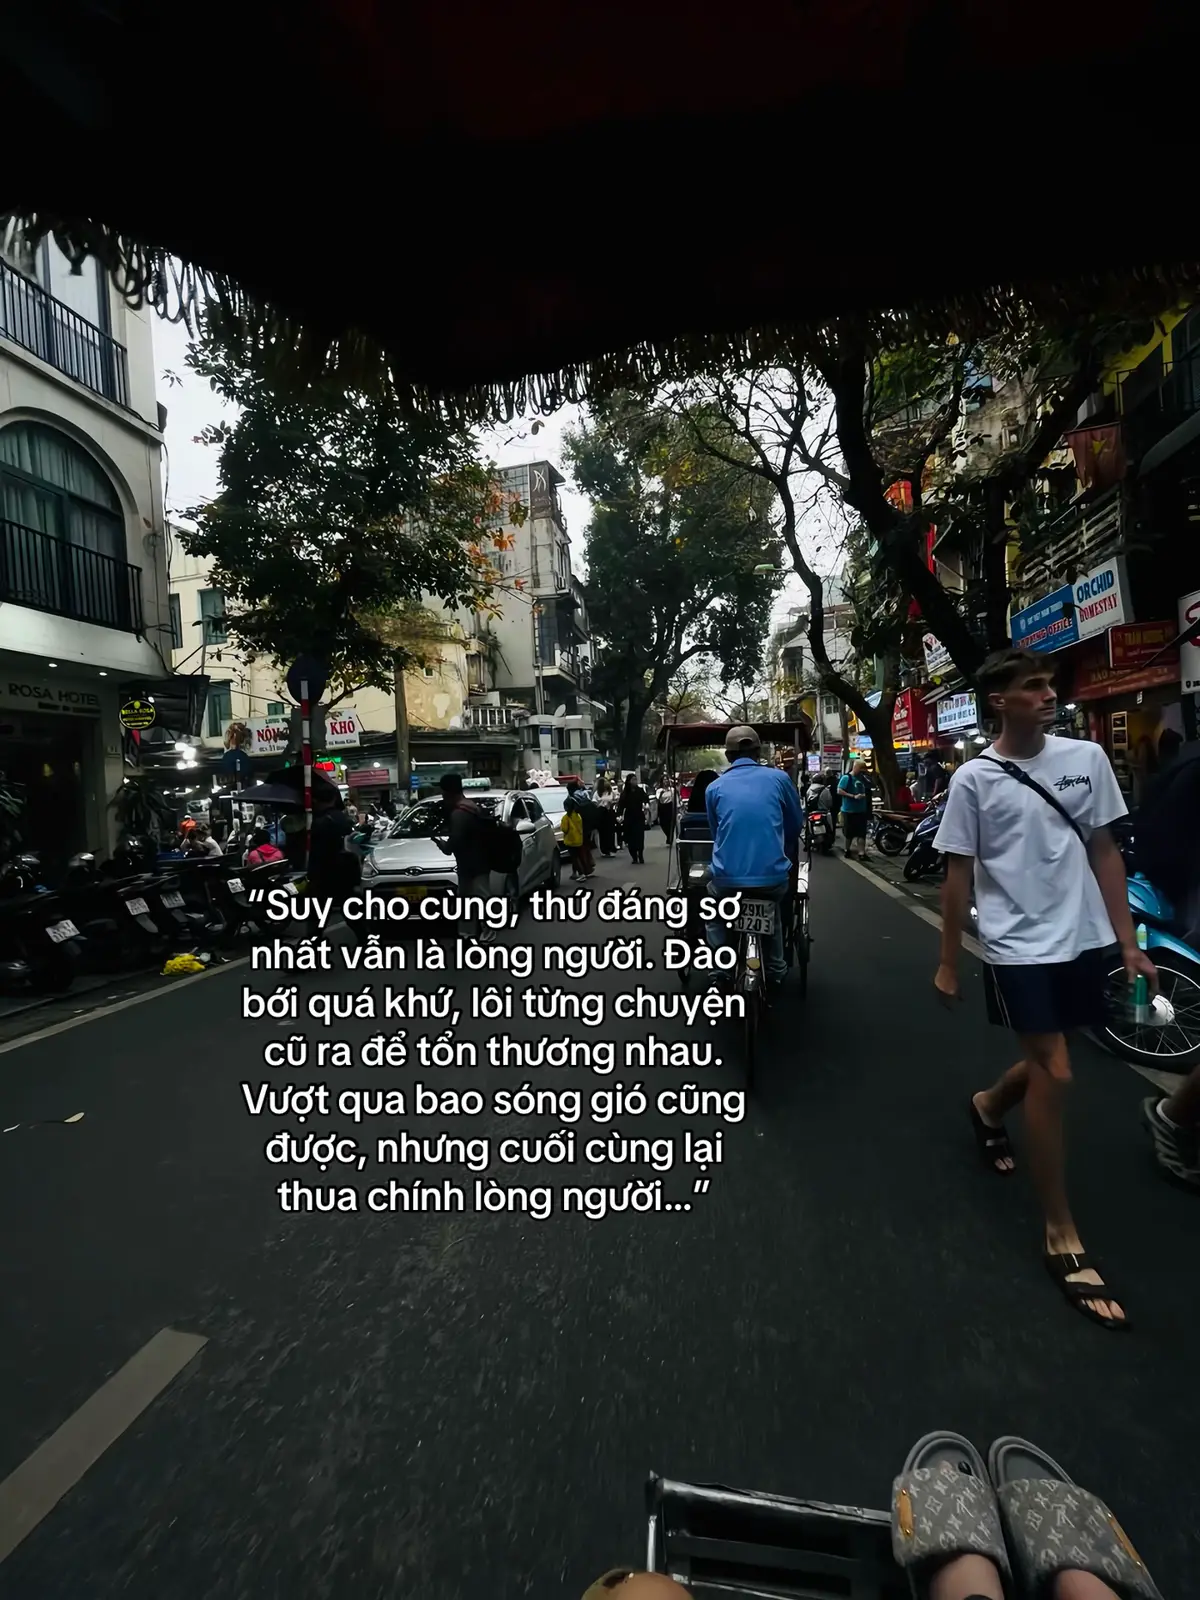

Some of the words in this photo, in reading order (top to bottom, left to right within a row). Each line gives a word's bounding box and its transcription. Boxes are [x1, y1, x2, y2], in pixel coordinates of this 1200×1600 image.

[1077, 570, 1114, 603] ORCHID
[1079, 593, 1117, 623] HOMESTAY
[8, 682, 54, 701] ROSA
[329, 716, 356, 735] KHÔ
